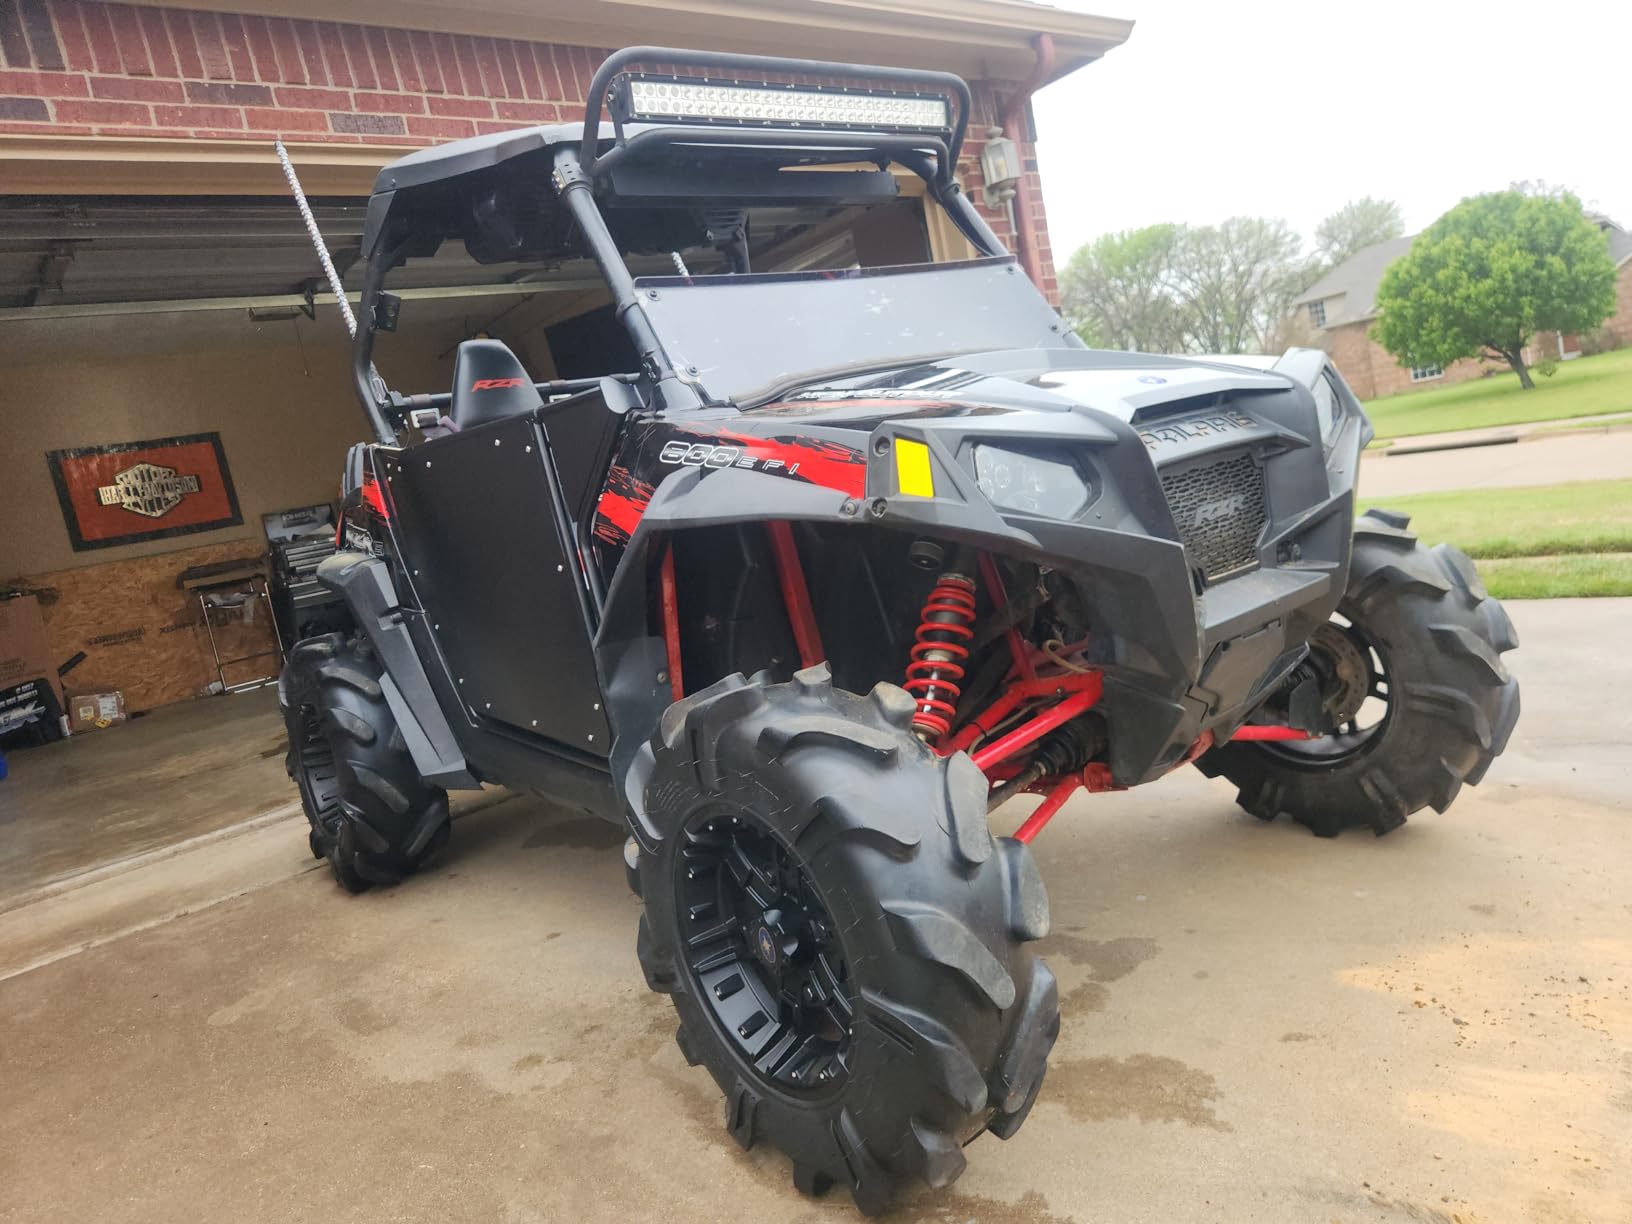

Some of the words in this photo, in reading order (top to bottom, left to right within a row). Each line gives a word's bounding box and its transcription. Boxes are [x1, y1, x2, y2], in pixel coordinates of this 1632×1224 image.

[471, 378, 526, 393] RZR
[660, 440, 740, 469] 800
[735, 455, 801, 475] EFI
